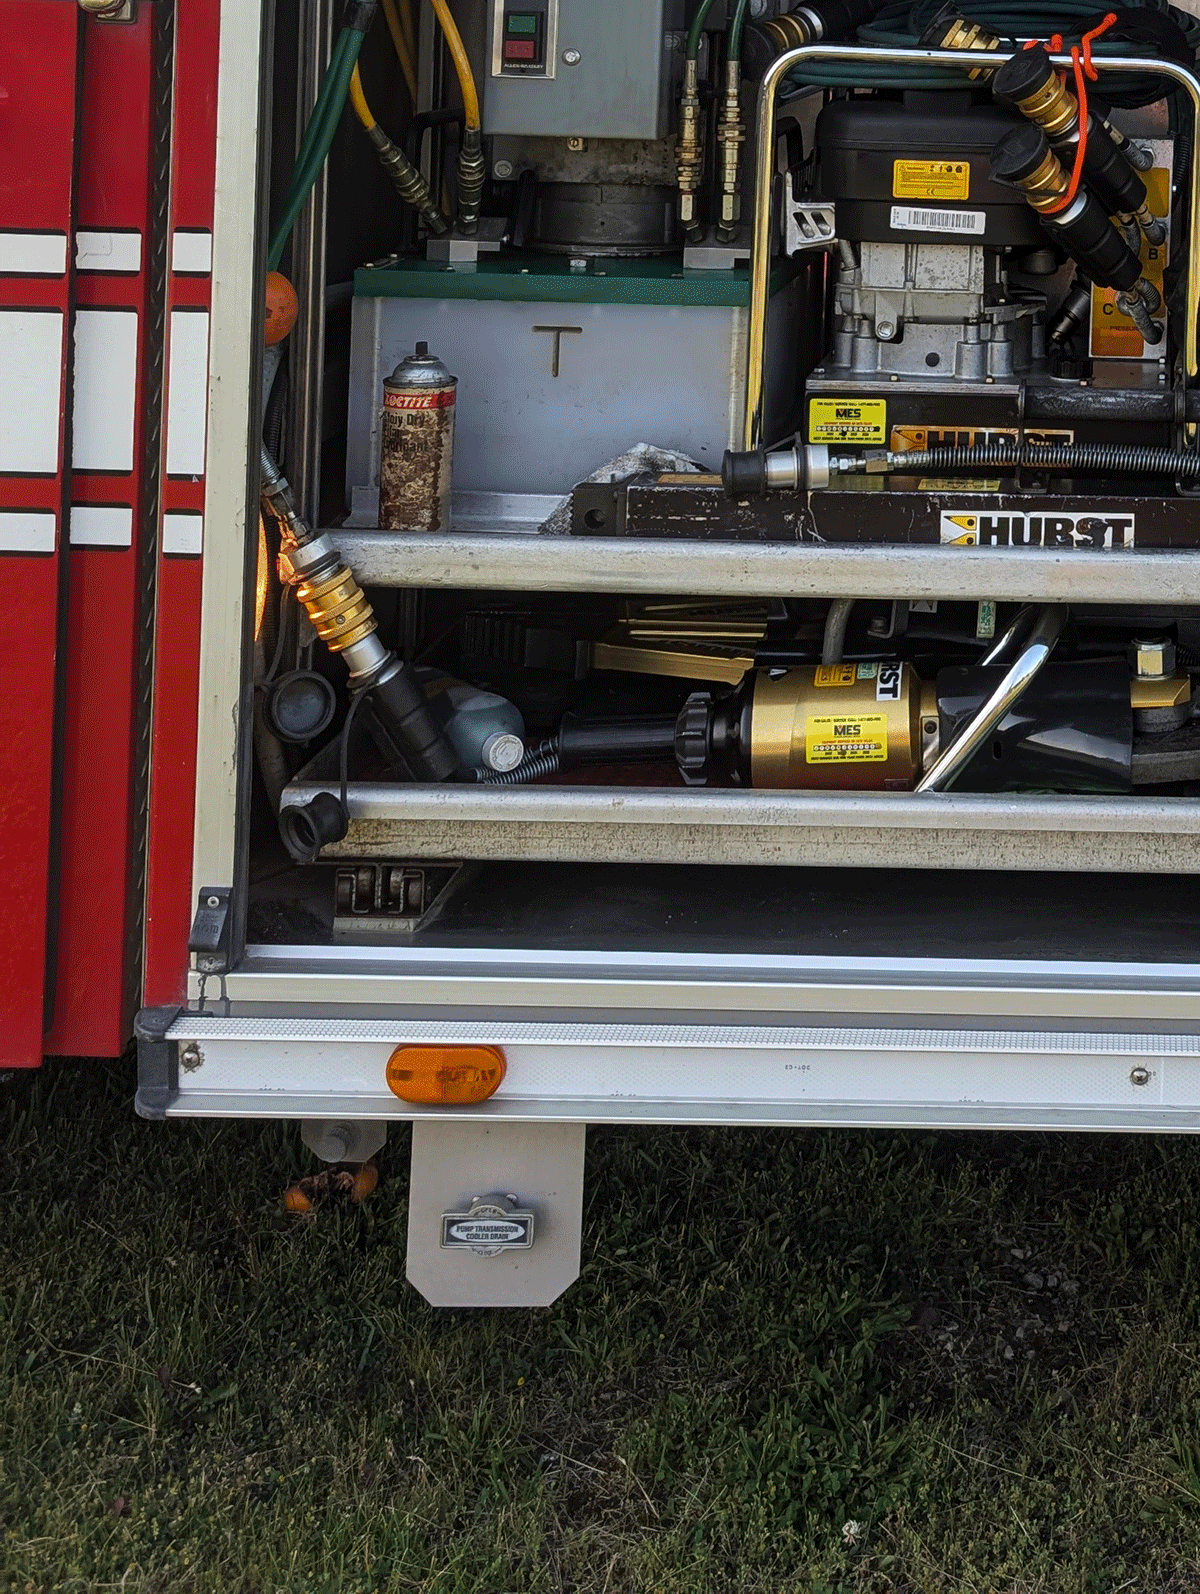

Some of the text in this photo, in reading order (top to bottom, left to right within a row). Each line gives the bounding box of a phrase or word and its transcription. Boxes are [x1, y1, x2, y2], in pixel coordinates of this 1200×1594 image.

[1102, 303, 1113, 316] C
[384, 394, 432, 408] LOCTITE
[835, 408, 861, 418] MES
[979, 516, 1133, 547] HURST
[834, 724, 861, 736] MES
[475, 1225, 519, 1233] TRANSMISSION
